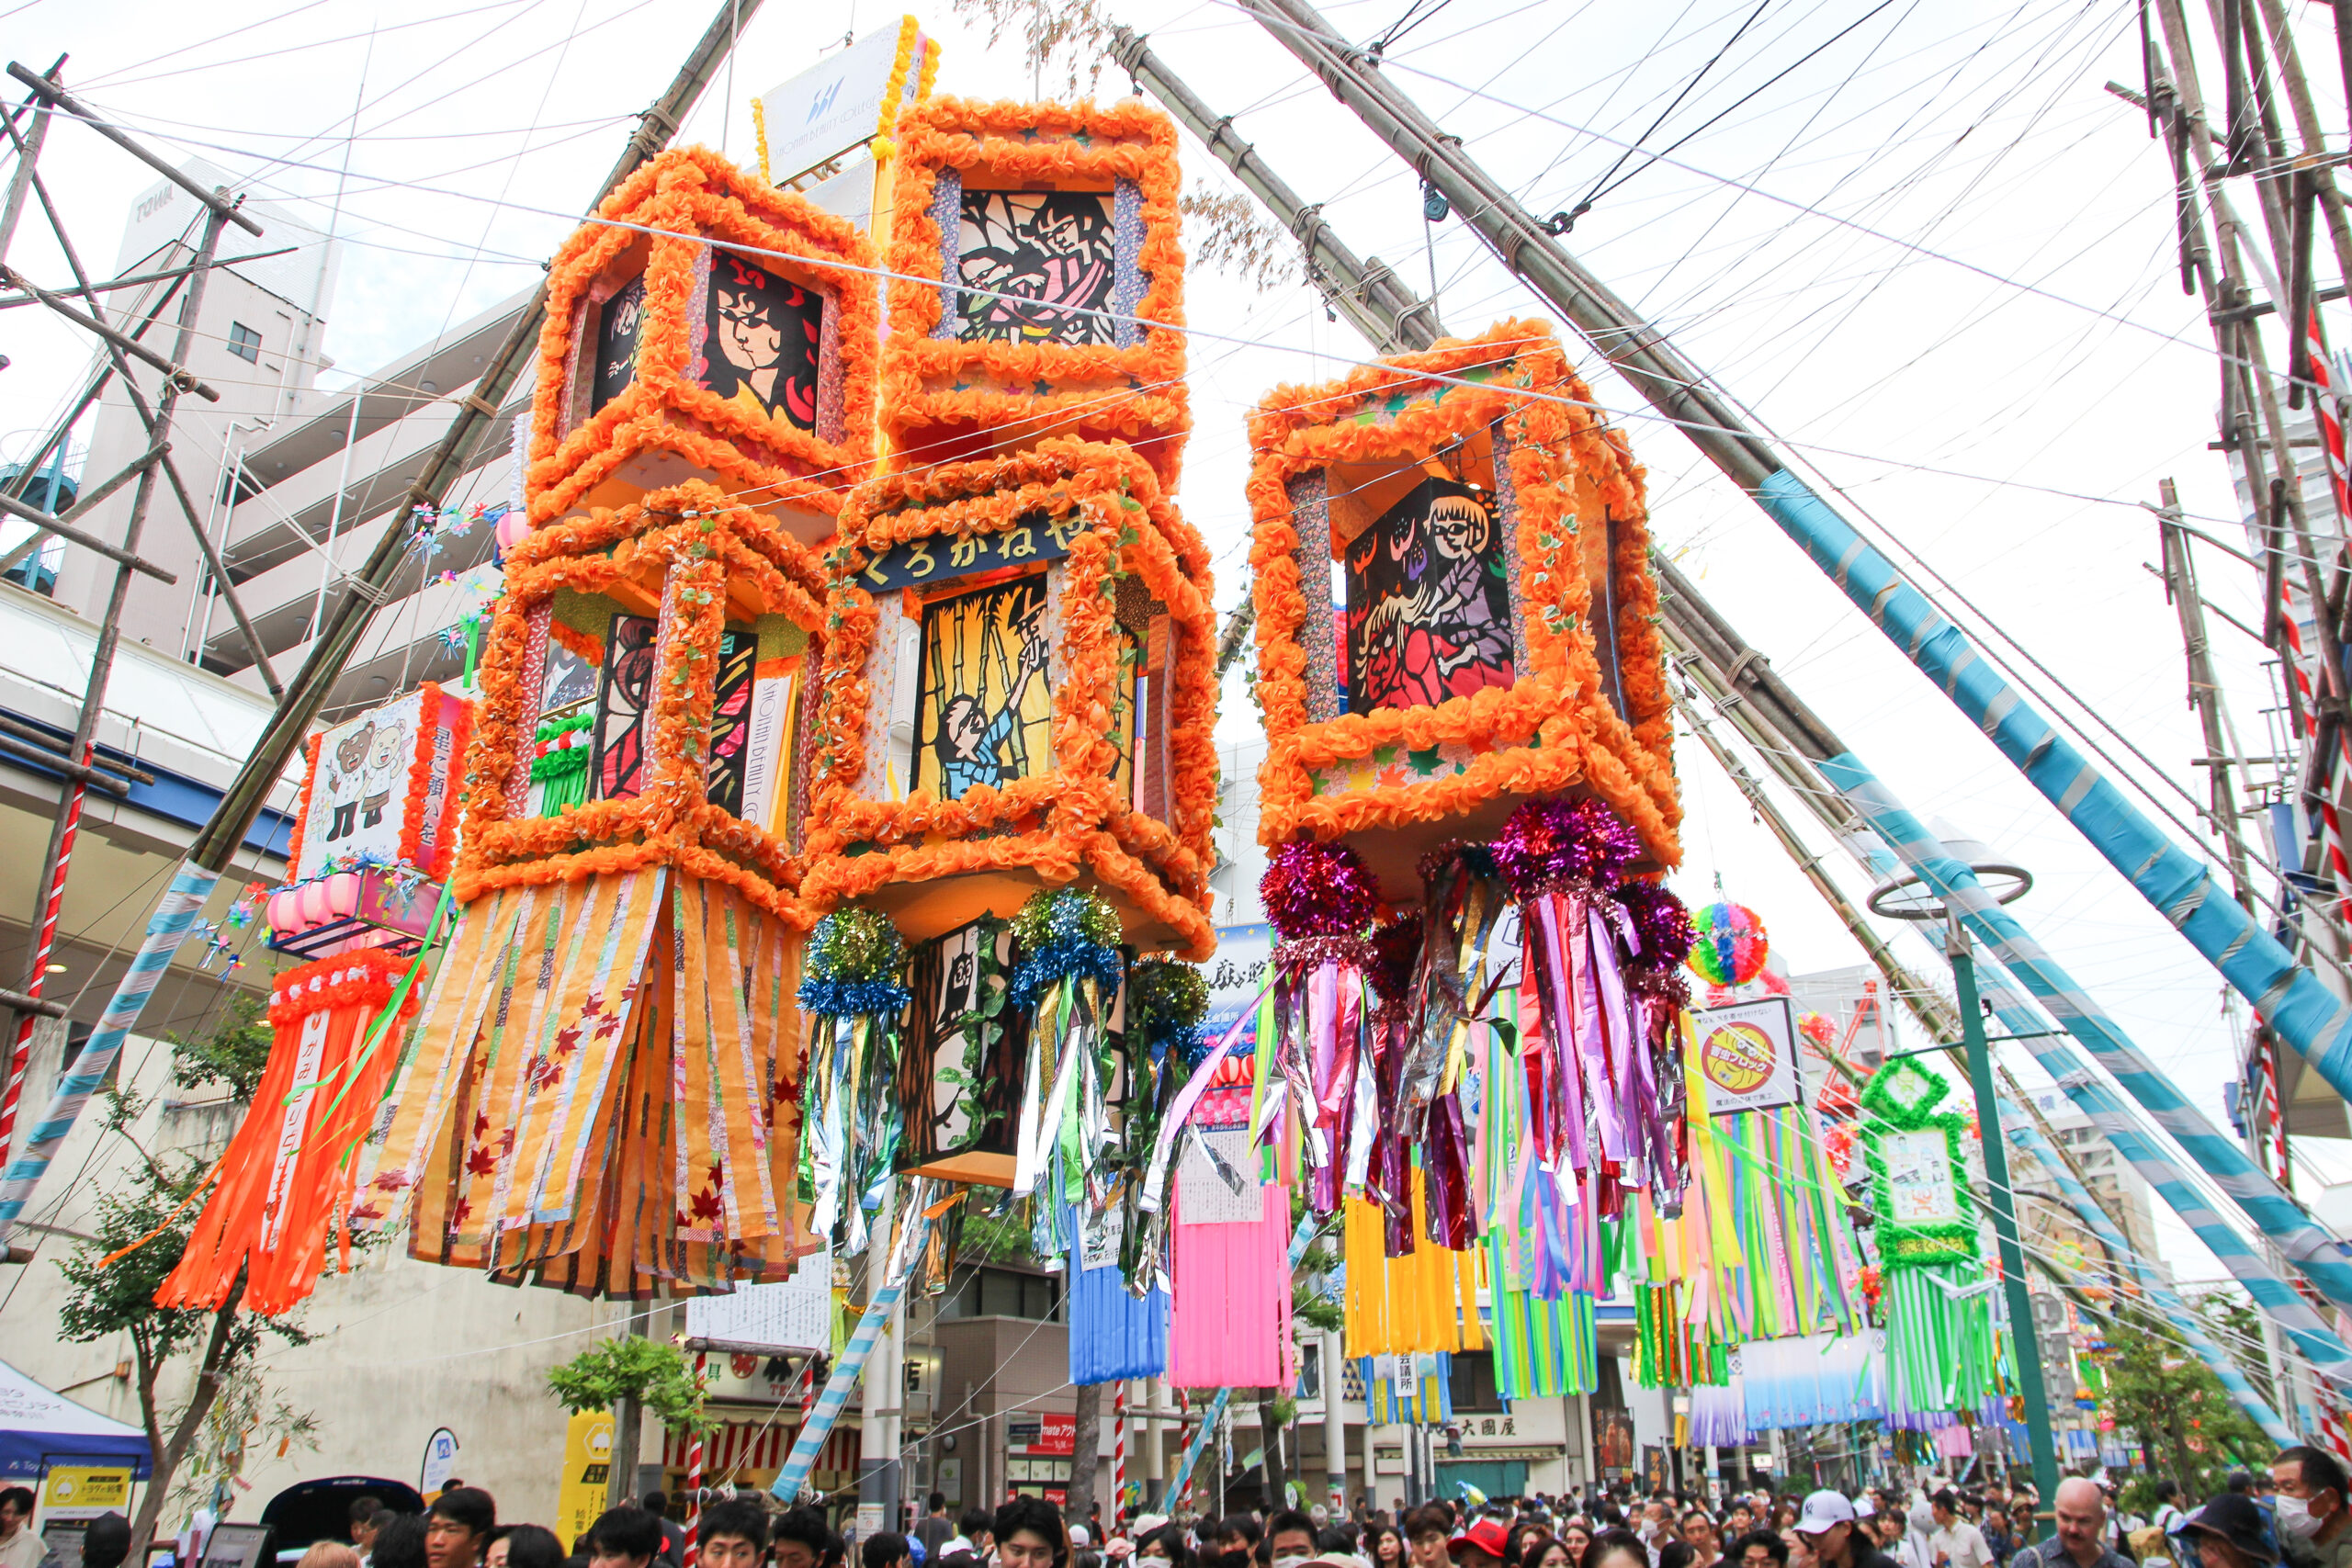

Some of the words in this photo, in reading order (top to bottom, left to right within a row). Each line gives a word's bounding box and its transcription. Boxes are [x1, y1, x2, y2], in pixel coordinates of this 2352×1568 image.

[136, 182, 175, 223] TOWA
[753, 682, 779, 745] SHONAN
[420, 727, 451, 847] 星に願いを
[745, 746, 768, 796] BEAUTY
